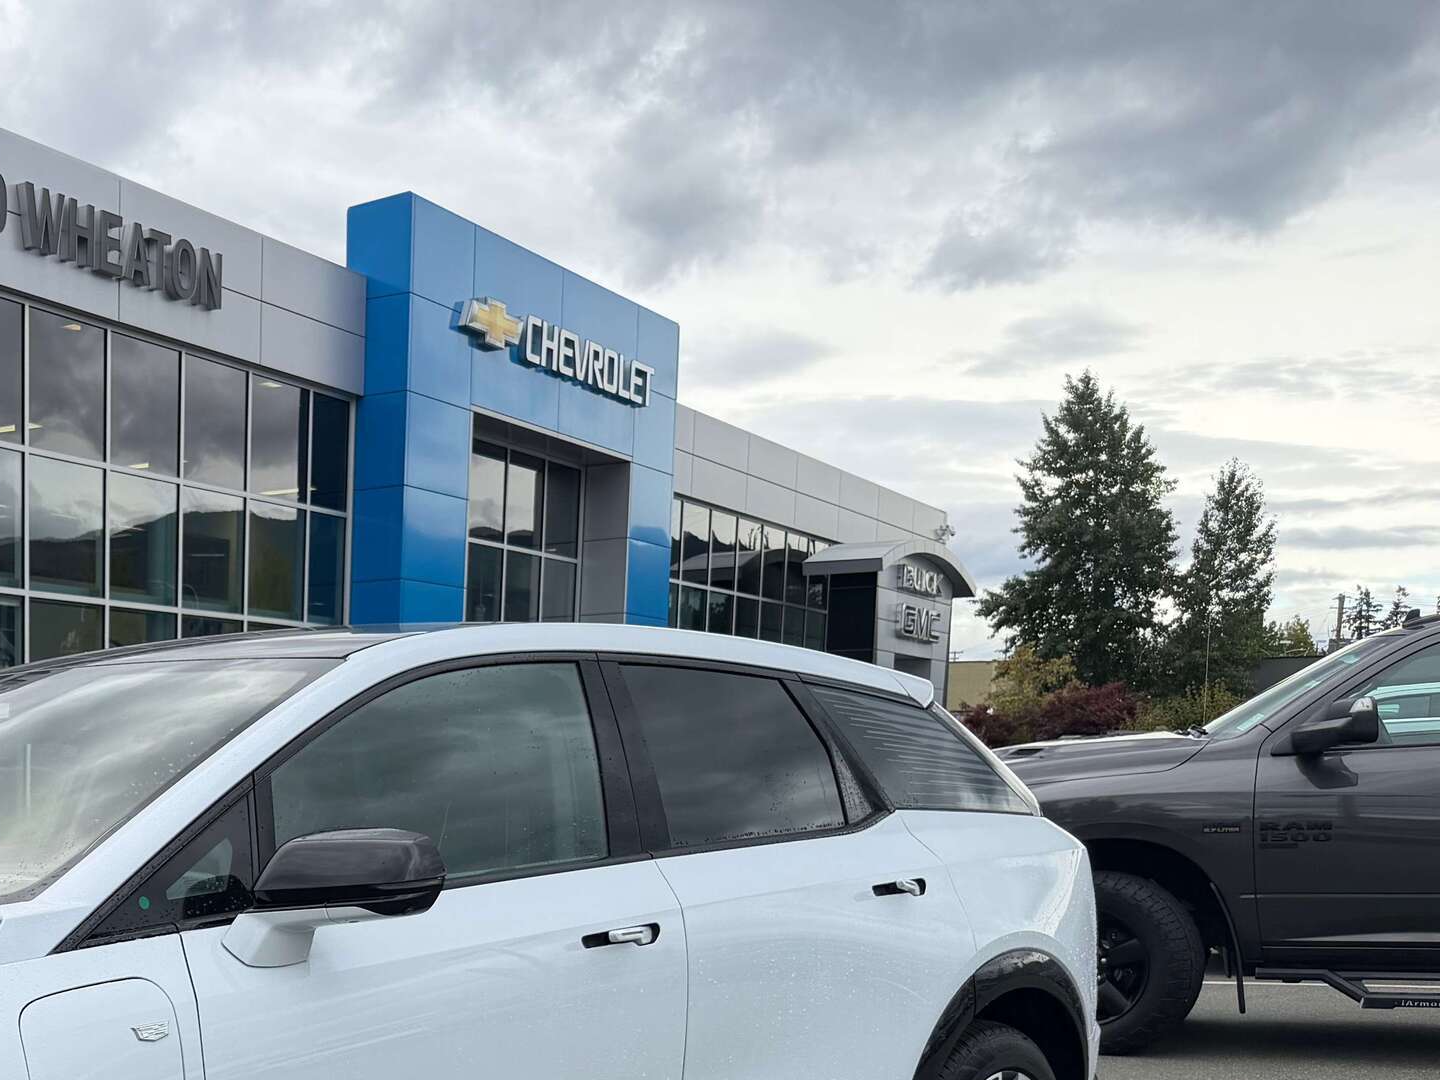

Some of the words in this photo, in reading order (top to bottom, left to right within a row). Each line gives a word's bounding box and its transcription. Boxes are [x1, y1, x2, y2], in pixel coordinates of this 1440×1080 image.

[15, 180, 223, 310] WHEATON
[526, 314, 655, 407] CHEVROLET
[901, 565, 943, 596] BUICK
[900, 602, 942, 642] GMC
[1259, 832, 1333, 842] 1500
[1401, 999, 1440, 1007] iArmo
